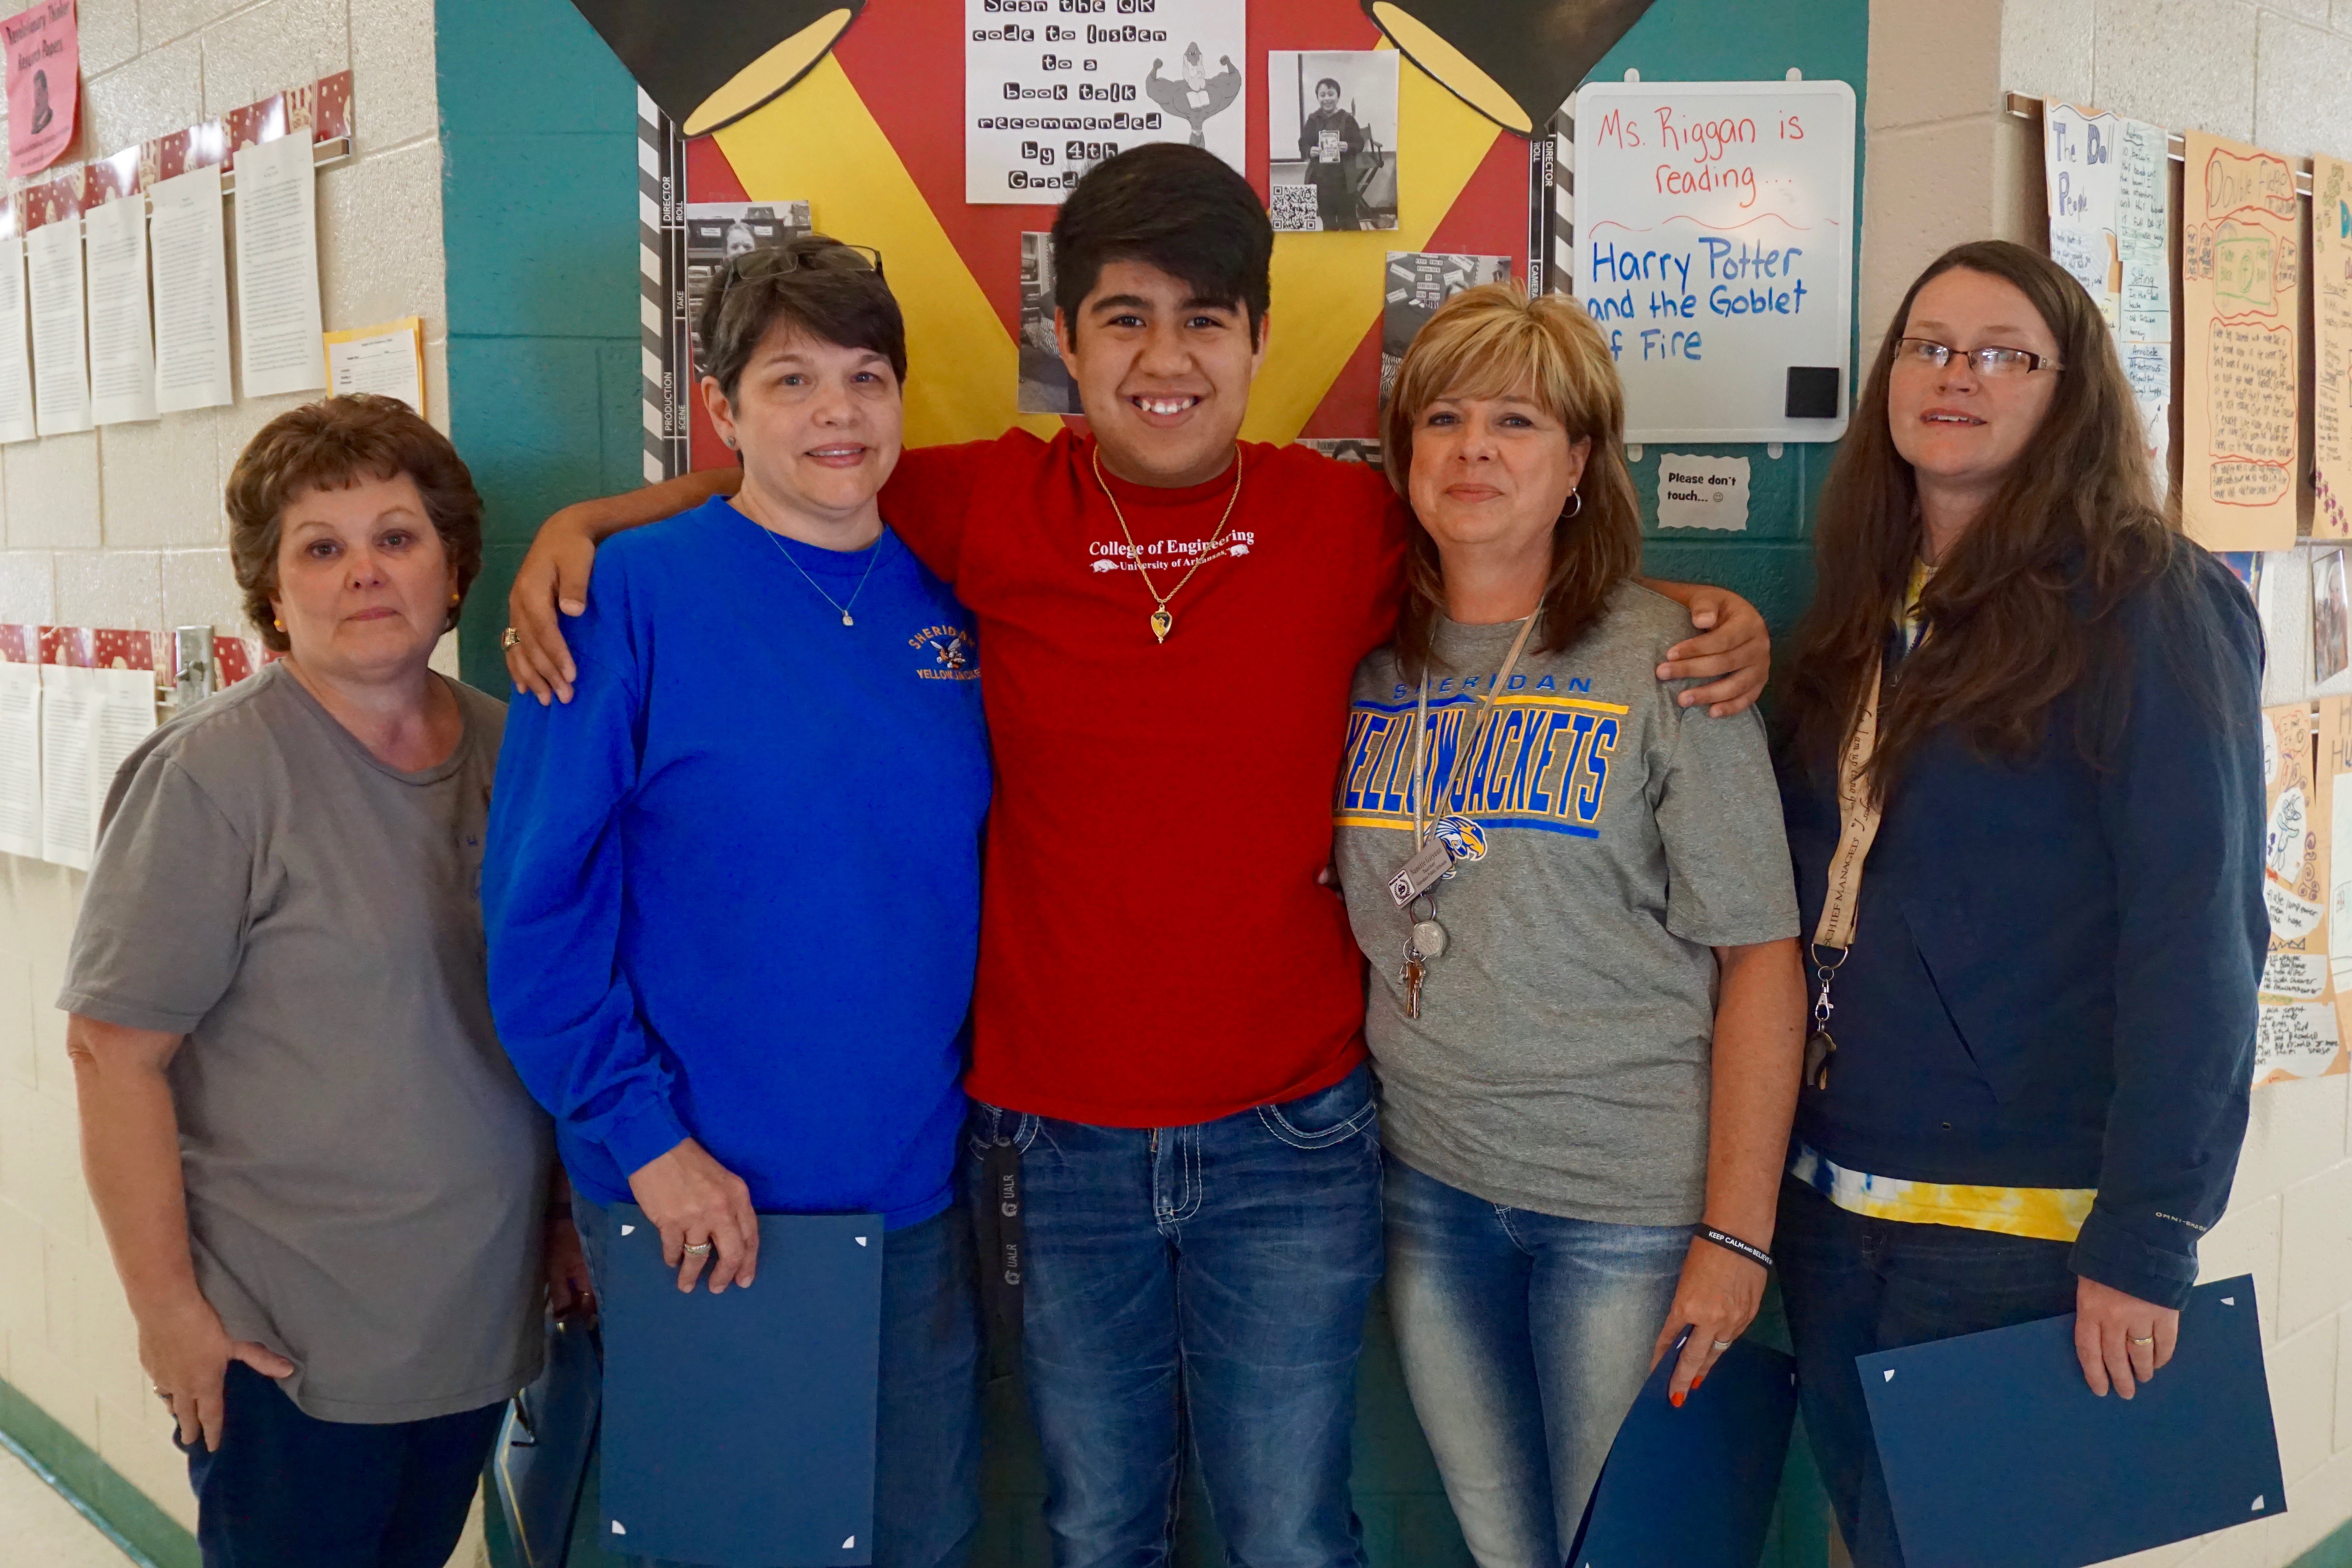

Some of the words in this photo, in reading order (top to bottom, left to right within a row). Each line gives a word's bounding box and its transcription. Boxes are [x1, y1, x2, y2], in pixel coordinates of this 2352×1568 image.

[984, 0, 1048, 12] Scan
[1059, 0, 1105, 13] the
[1117, 0, 1154, 13] QR
[972, 24, 1034, 41] code
[1045, 25, 1075, 41] to
[1087, 24, 1167, 44] listen
[1042, 54, 1072, 71] to
[1083, 59, 1097, 71] a
[1003, 82, 1067, 100] book
[1079, 83, 1136, 102] talk
[978, 112, 1161, 130] recommended
[1598, 109, 1646, 149] Ms.
[1655, 107, 1756, 163] Riggan
[1779, 111, 1804, 140] is
[2053, 121, 2076, 162] The
[2087, 123, 2115, 165] Doll
[1021, 141, 1054, 165] by
[1066, 140, 1118, 160] 4th
[1532, 142, 1541, 162] ROLL
[1544, 141, 1553, 187] DIRECTOR
[1008, 170, 1078, 189] Grad
[662, 176, 671, 221] DIRECTOR
[2059, 171, 2088, 223] People
[1593, 241, 1691, 294] Harry
[1699, 237, 1802, 279] Potter
[1531, 265, 1539, 298] CAMERA
[2132, 267, 2154, 294] Setting
[1588, 289, 1634, 321] and
[1650, 291, 1697, 318] the
[1710, 278, 1807, 318] Goblet
[1610, 330, 1623, 361] f
[1641, 329, 1702, 361] Fire
[664, 372, 672, 431] PRODUCTION
[1668, 472, 1704, 484] Please
[1708, 475, 1736, 486] don't
[1089, 541, 1144, 559] College
[1148, 540, 1164, 554] of
[1167, 529, 1254, 555] Engineering
[1120, 561, 1169, 570] University
[1171, 558, 1181, 567] of
[916, 669, 953, 679] YELLOW
[1853, 737, 1860, 750] am
[1850, 753, 1859, 767] up
[1849, 784, 1856, 793] no
[1004, 1175, 1014, 1198] UALR
[1006, 1244, 1018, 1268] UALR
[1709, 1231, 1724, 1240] KEEP
[1725, 1237, 1744, 1249] CALM
[1753, 1249, 1770, 1263] BELIEVE
